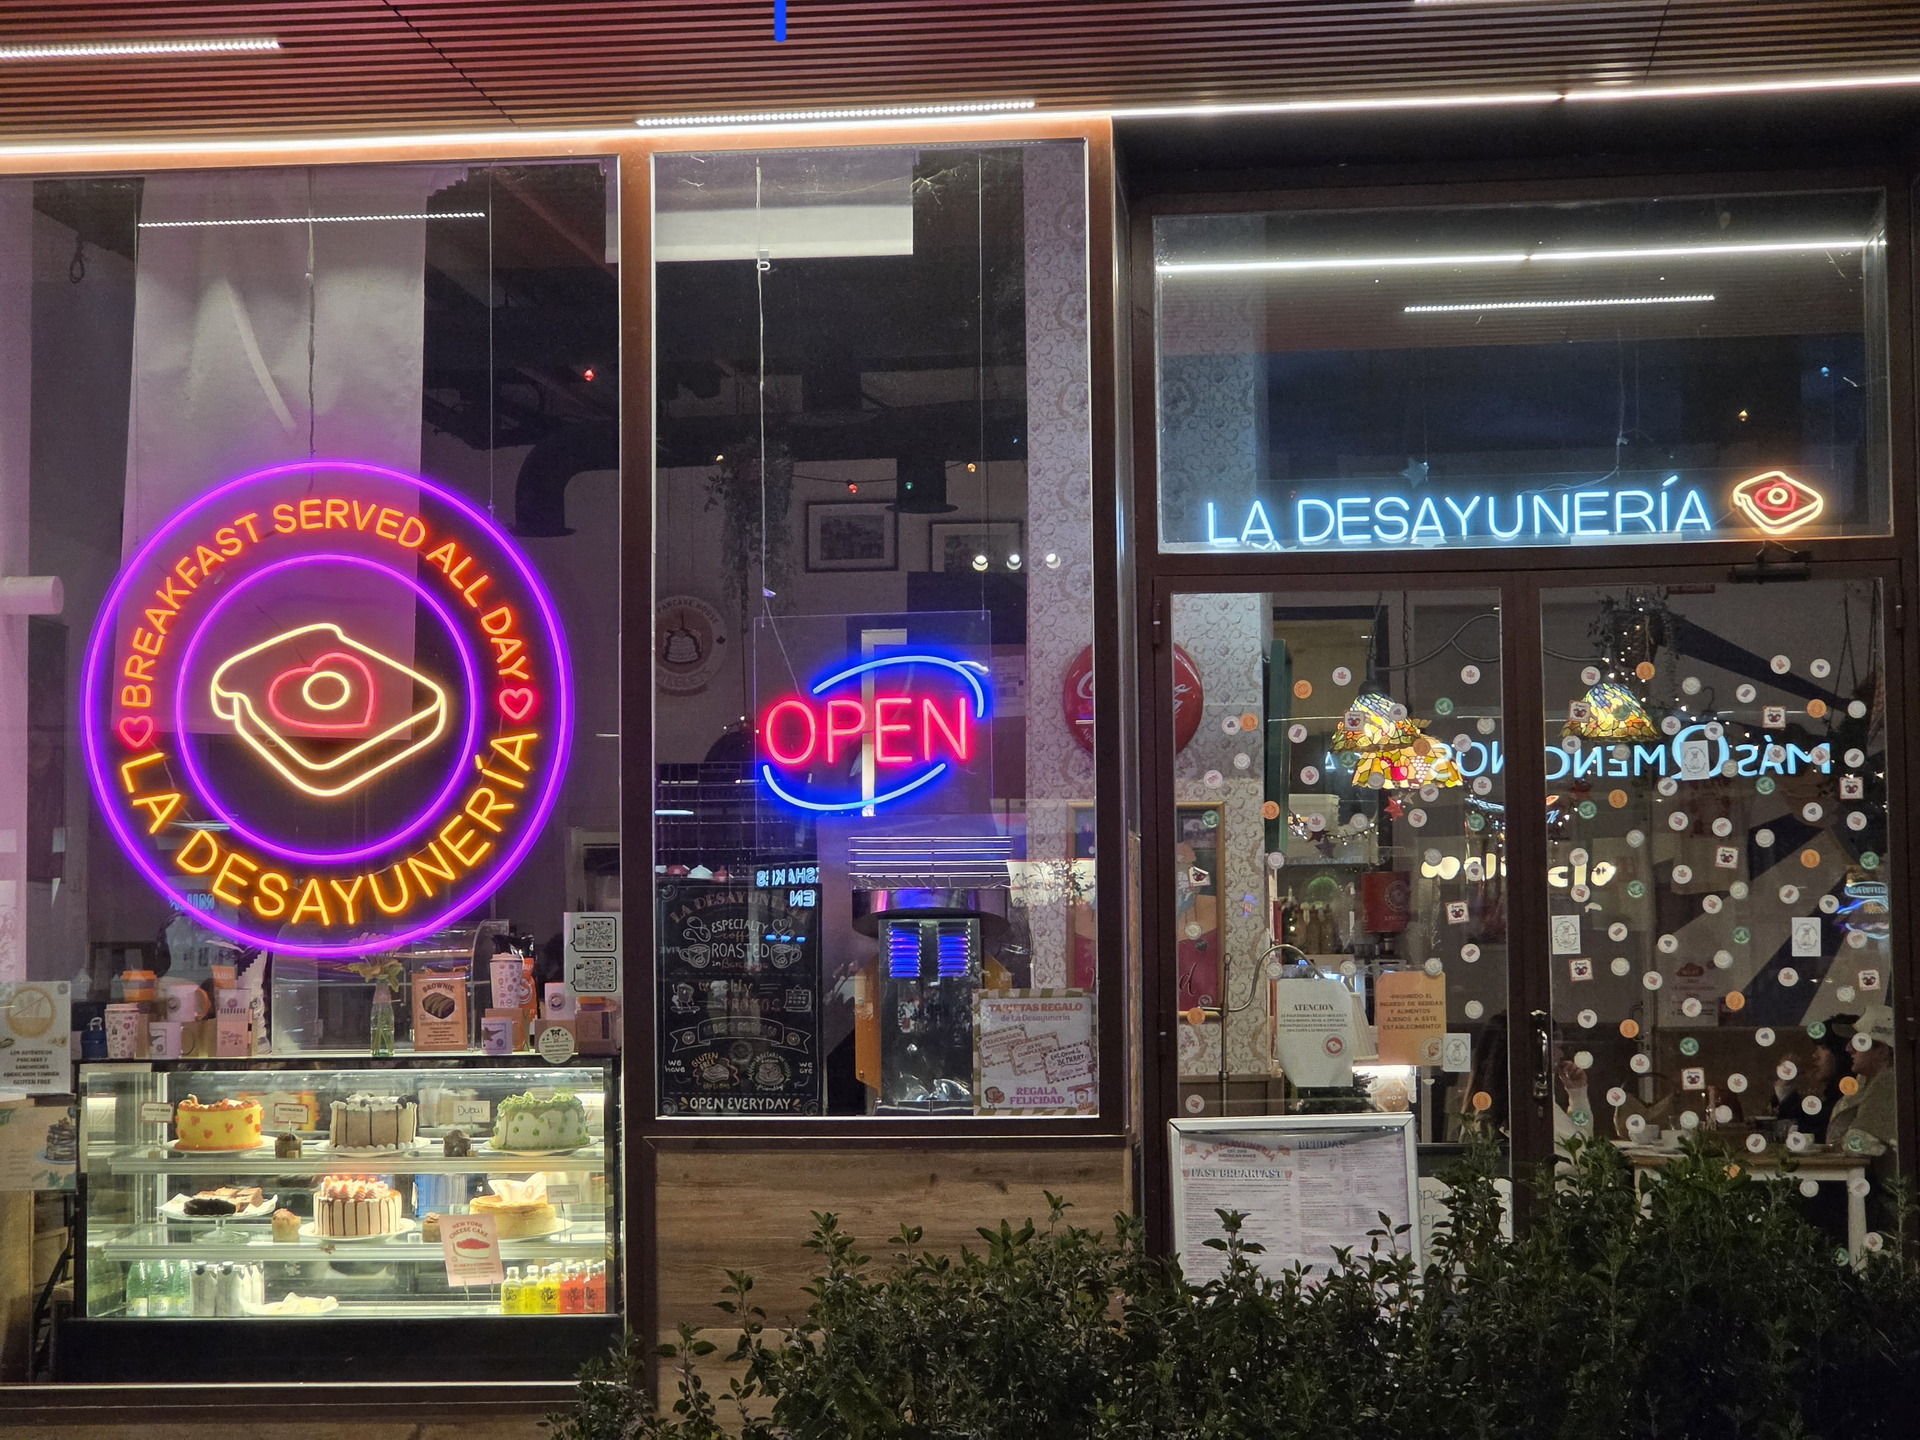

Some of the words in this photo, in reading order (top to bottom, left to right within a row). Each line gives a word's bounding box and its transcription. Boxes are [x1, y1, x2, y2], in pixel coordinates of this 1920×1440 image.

[1207, 502, 1278, 546] LA
[1299, 475, 1713, 544] DESAYUNERÍA
[121, 512, 262, 708] BREAKFAST
[272, 498, 427, 549] SERVED
[425, 541, 490, 609] ALL
[480, 605, 528, 682] DAY
[764, 697, 968, 764] OPEN
[121, 751, 182, 834] LA
[176, 731, 539, 926] DESAYUNERÍA
[711, 918, 769, 933] ESPECIALTY
[711, 943, 770, 959] ROASTED
[422, 982, 455, 993] BROWNIE
[1041, 1002, 1083, 1012] REGALO
[691, 1051, 720, 1068] GLUTEN
[664, 1064, 686, 1073] have
[1016, 1086, 1058, 1096] REGALA
[689, 1097, 725, 1111] OPEN
[727, 1097, 792, 1111] EVERYDAY
[1009, 1096, 1066, 1105] FELICIDAD
[457, 1105, 484, 1116] Dubai
[1220, 1168, 1283, 1179] BREAKFAST
[451, 1221, 466, 1230] NEW
[466, 1221, 484, 1229] YORK
[449, 1228, 472, 1239] CHEESE
[472, 1227, 489, 1238] CAKE
